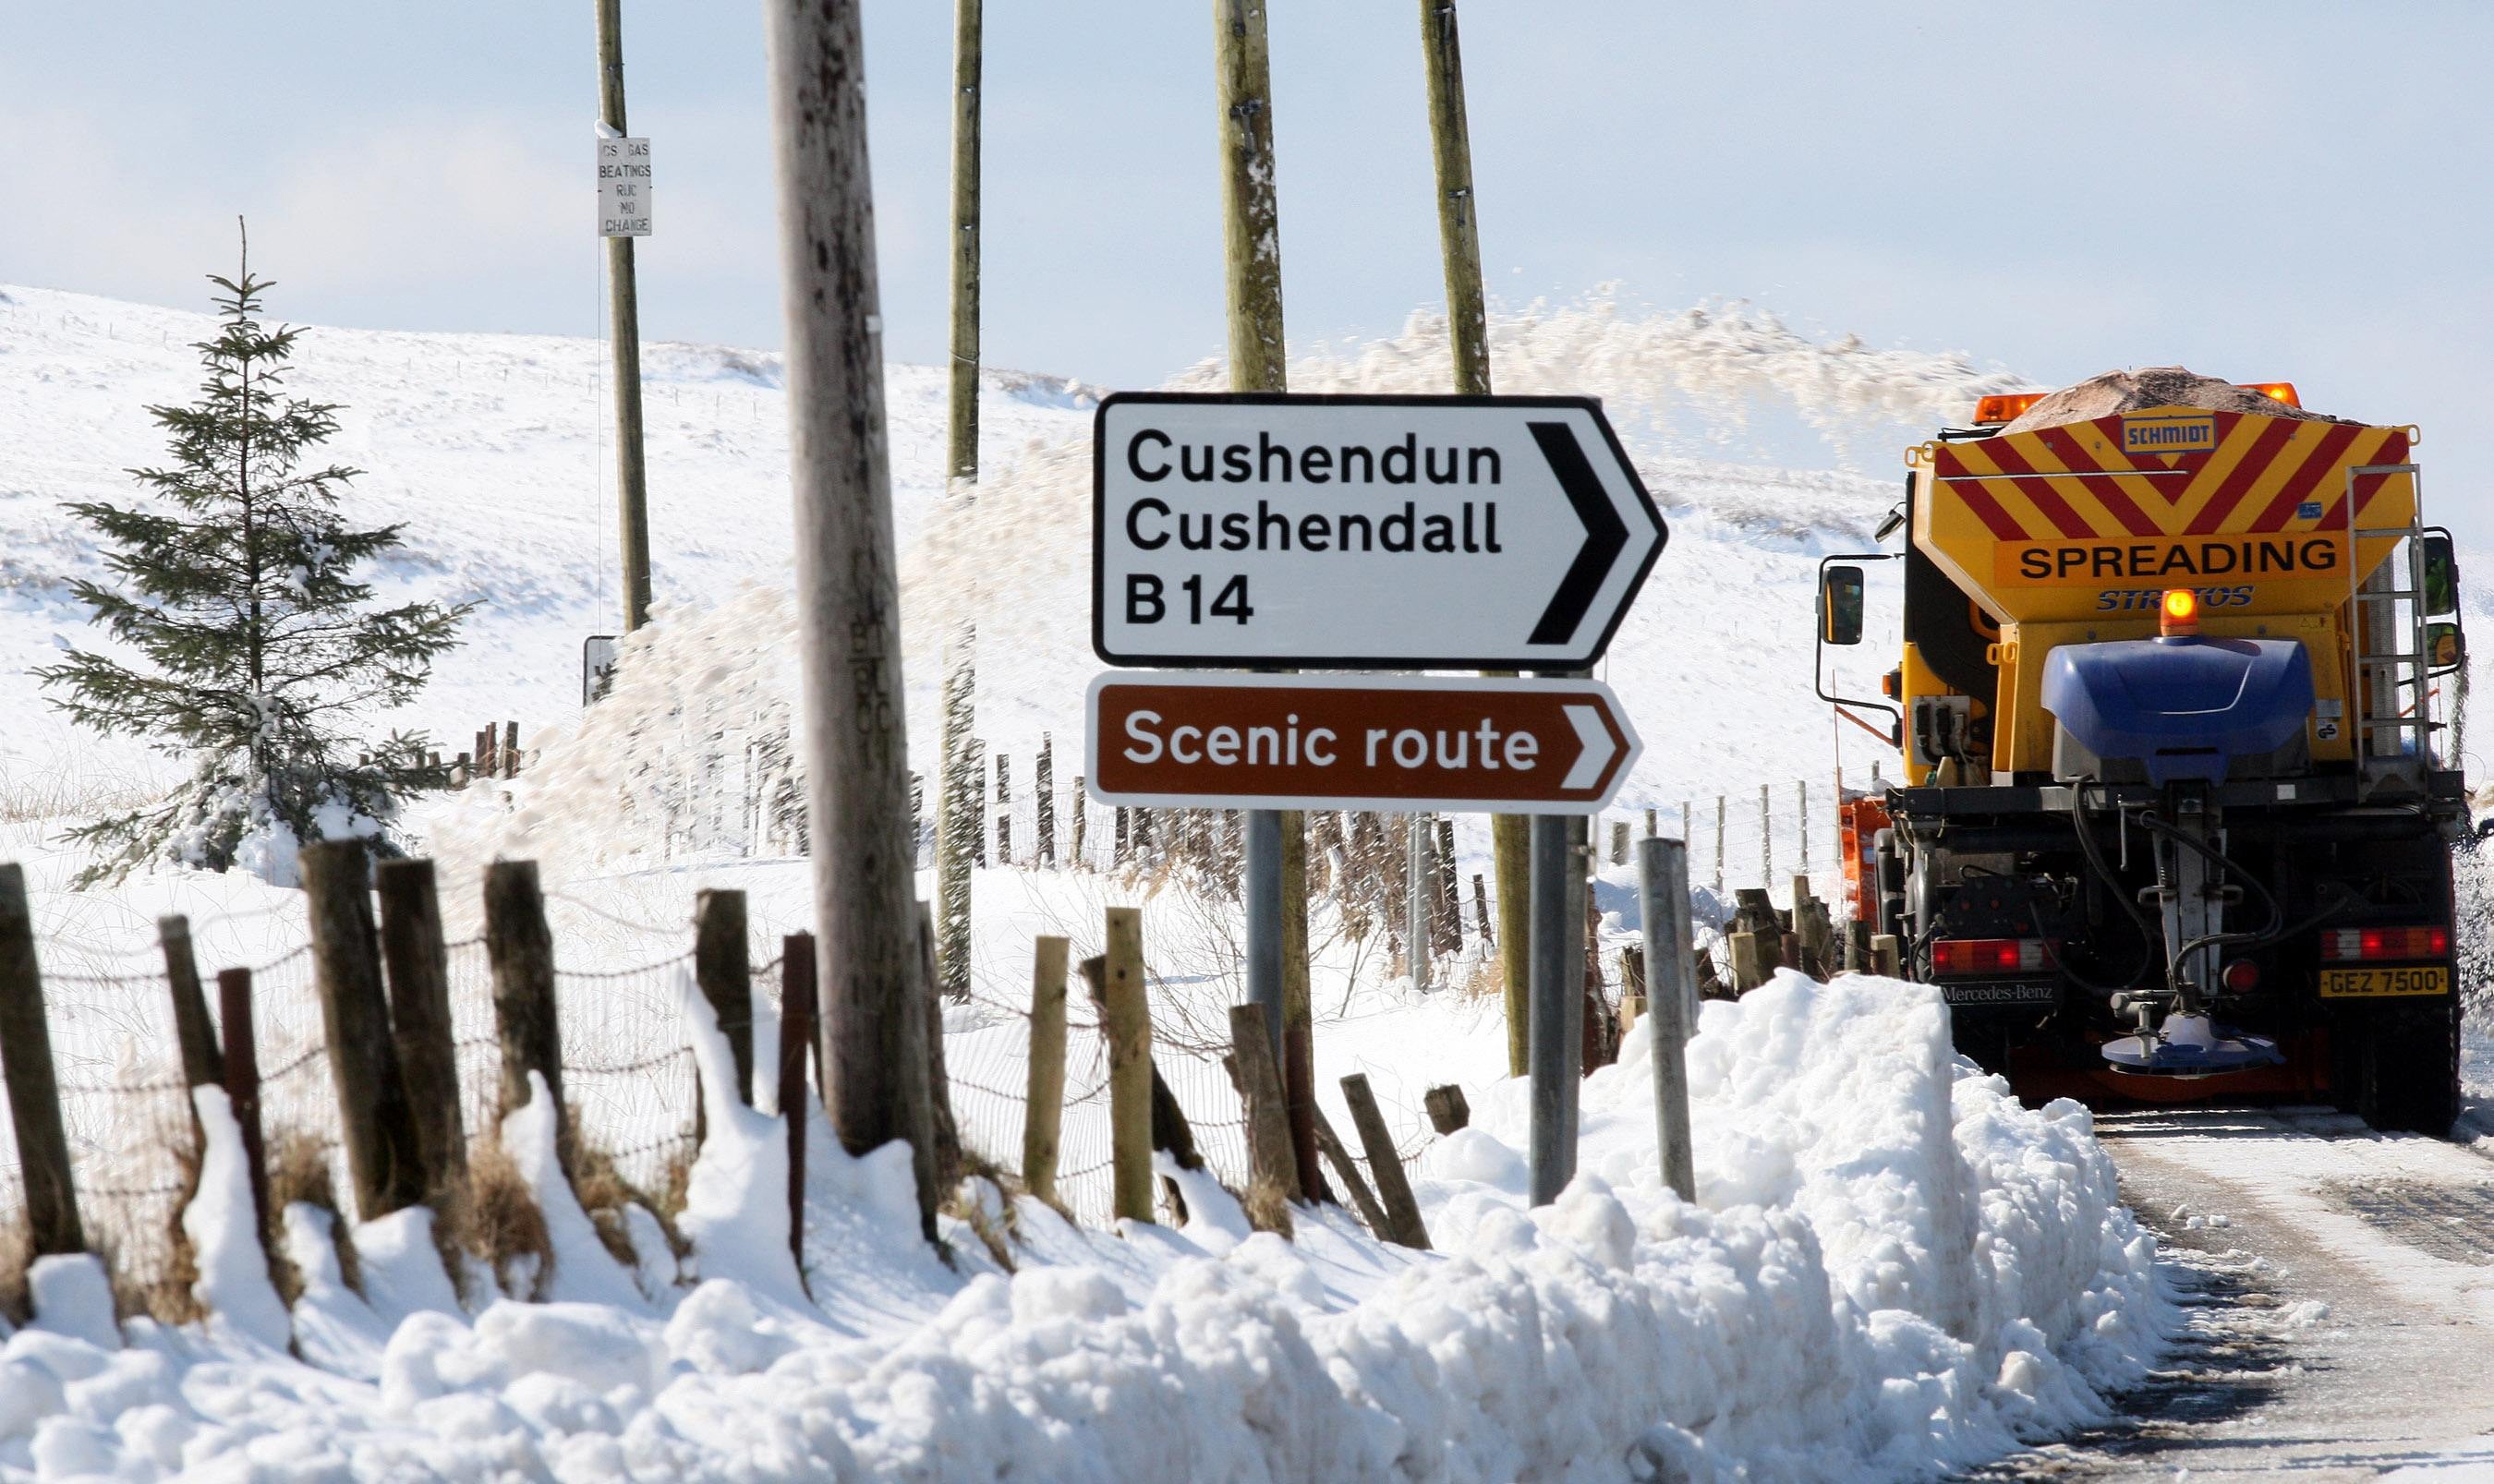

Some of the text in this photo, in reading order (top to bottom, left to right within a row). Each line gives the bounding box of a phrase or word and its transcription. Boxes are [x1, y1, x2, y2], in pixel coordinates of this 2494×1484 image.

[602, 143, 648, 157] CS GAS
[599, 164, 651, 178] BEATINGS
[616, 184, 637, 197] RUC
[605, 218, 648, 233] CHANGE
[2128, 425, 2209, 445] SCHMIDT
[1126, 428, 1503, 486] Cushendun
[1124, 497, 1503, 554] Cushendall
[2019, 538, 2337, 580] SPREADING
[2096, 585, 2255, 611] STRTOS
[1122, 709, 1540, 770] Scenic route
[1942, 984, 2053, 1001] Mercedes-Benz
[2330, 970, 2439, 994] GEZ 7500
